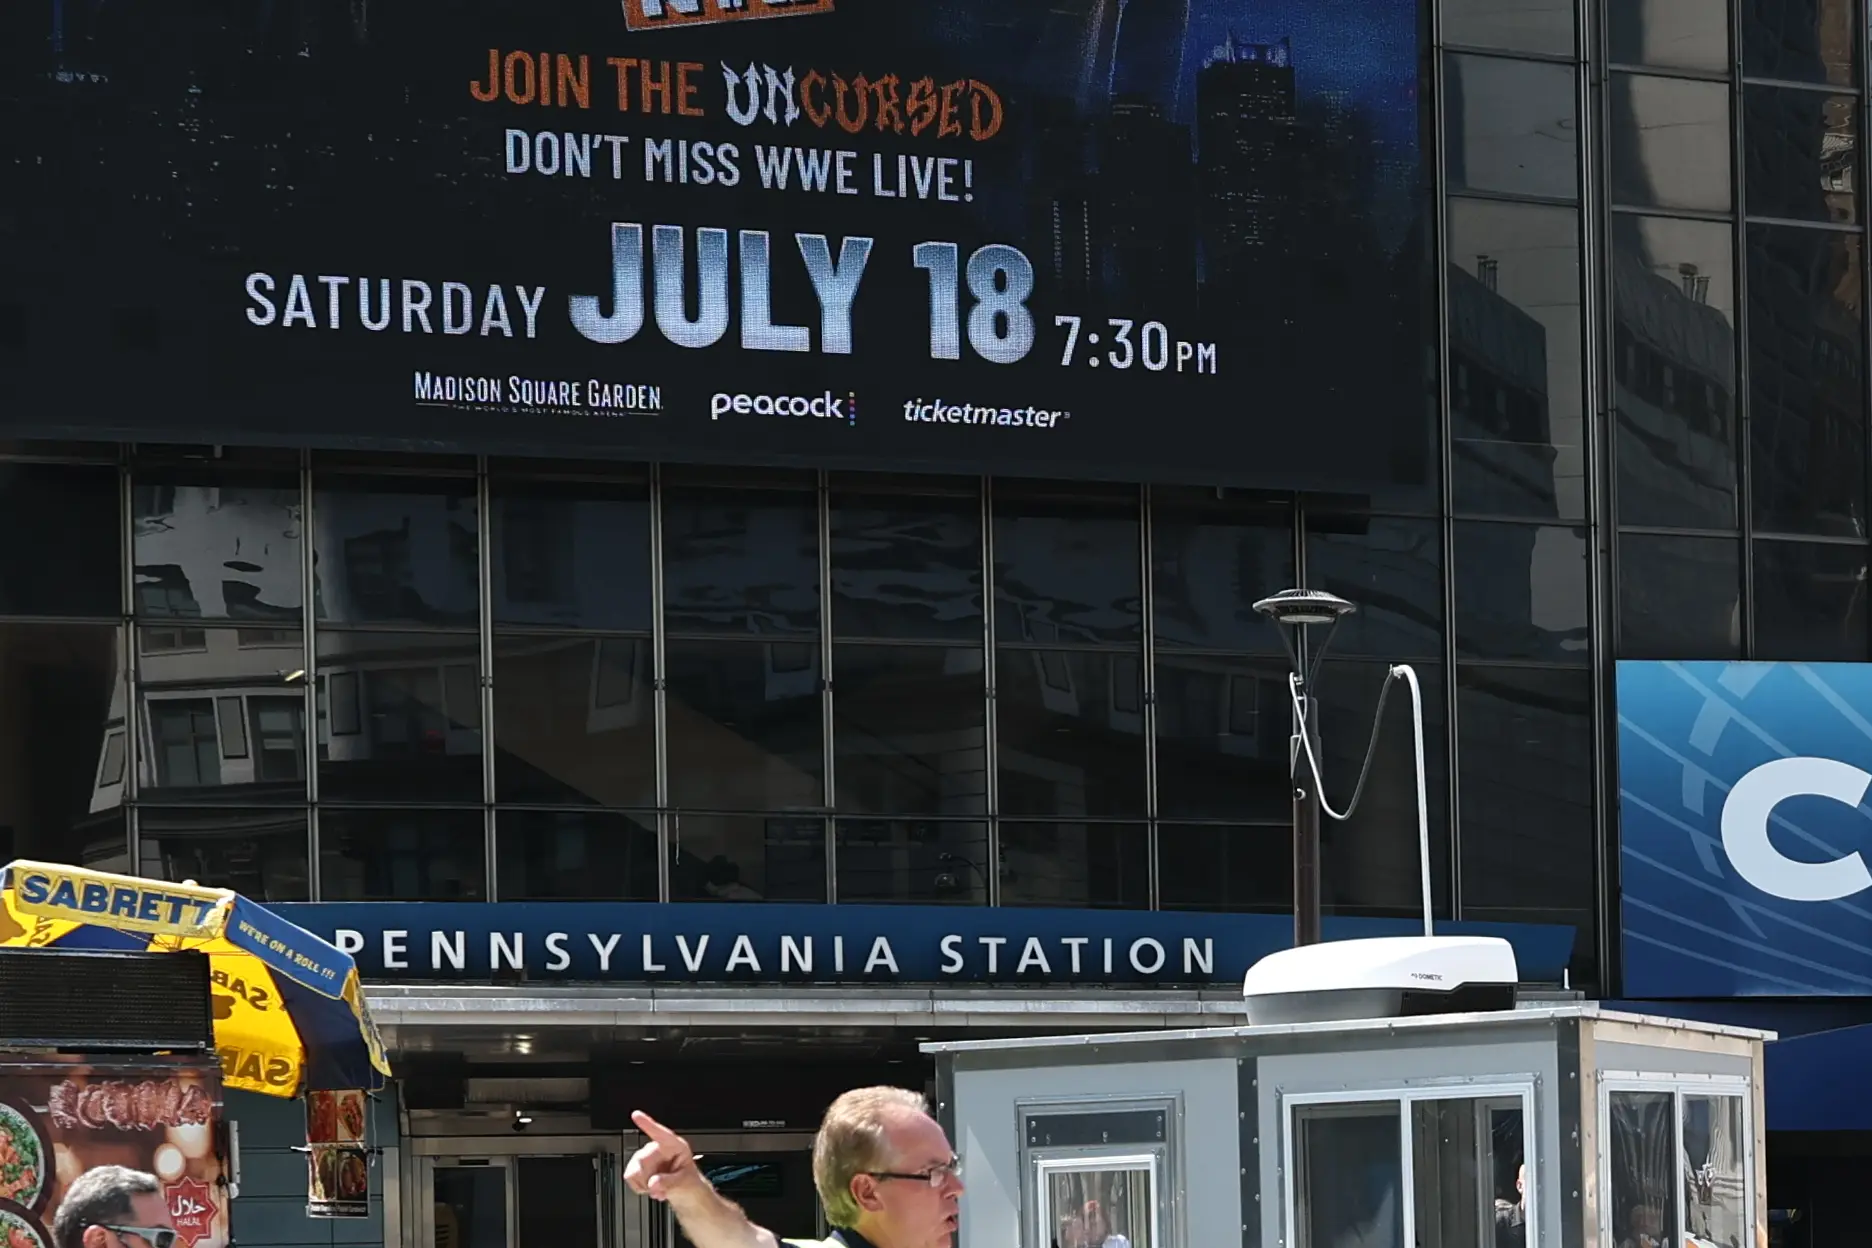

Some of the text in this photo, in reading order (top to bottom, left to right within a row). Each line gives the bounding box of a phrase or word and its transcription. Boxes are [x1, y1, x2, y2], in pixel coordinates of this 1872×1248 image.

[470, 48, 1005, 141] JOIN THE UNCURSED
[505, 128, 974, 202] DON'T MISS WWE LIVE!
[244, 272, 546, 339] SATURDAY
[568, 222, 874, 355] JULY
[912, 240, 1036, 364] 18
[711, 390, 843, 420] peacock
[903, 397, 1062, 429] ticketmaster
[269, 939, 287, 955] ON
[285, 948, 294, 962] A
[293, 952, 320, 974] ROLL
[335, 929, 1214, 975] PENNSYLVANIA STATION
[171, 1194, 207, 1217] حلال
[176, 1217, 201, 1227] HALAL
